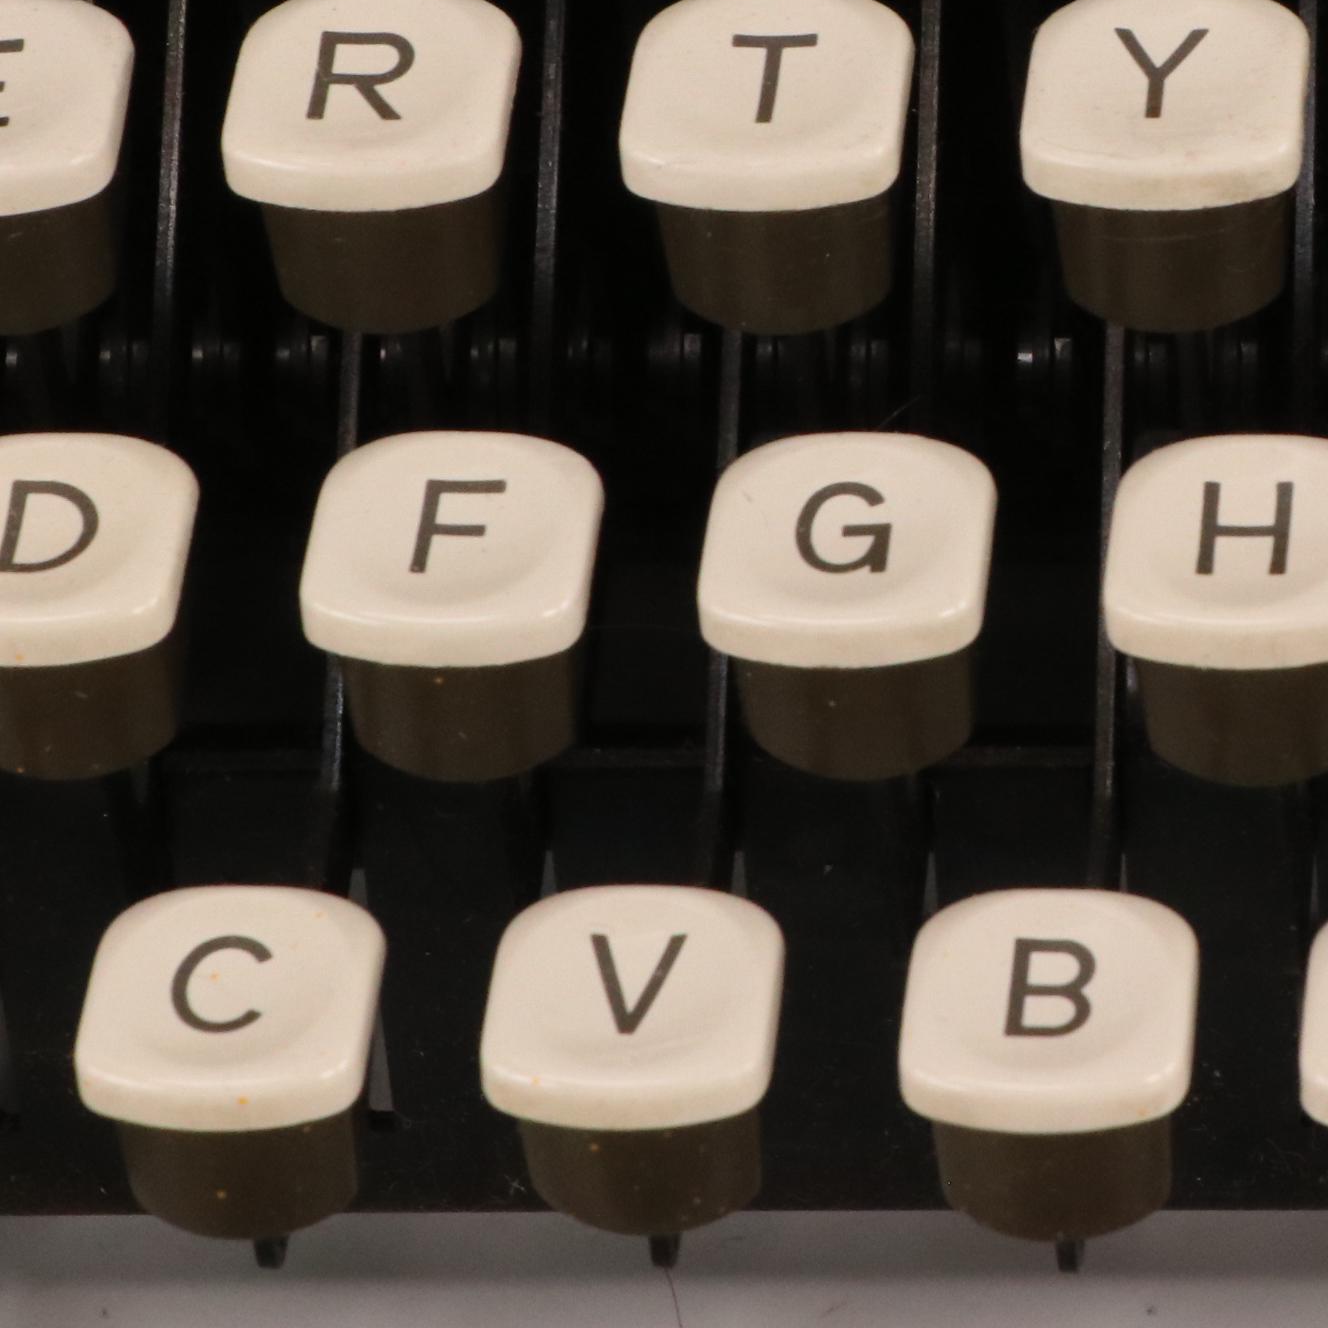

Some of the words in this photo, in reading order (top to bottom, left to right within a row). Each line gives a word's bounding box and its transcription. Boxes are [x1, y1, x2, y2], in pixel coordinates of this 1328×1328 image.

[306, 30, 415, 121] R
[732, 33, 818, 124] T
[1114, 27, 1209, 119] Y
[0, 479, 99, 574] D
[409, 479, 507, 574] F
[795, 481, 892, 574] G
[1195, 481, 1293, 576] H
[171, 935, 272, 1034] C
[591, 933, 687, 1035] V
[1004, 937, 1096, 1038] B
